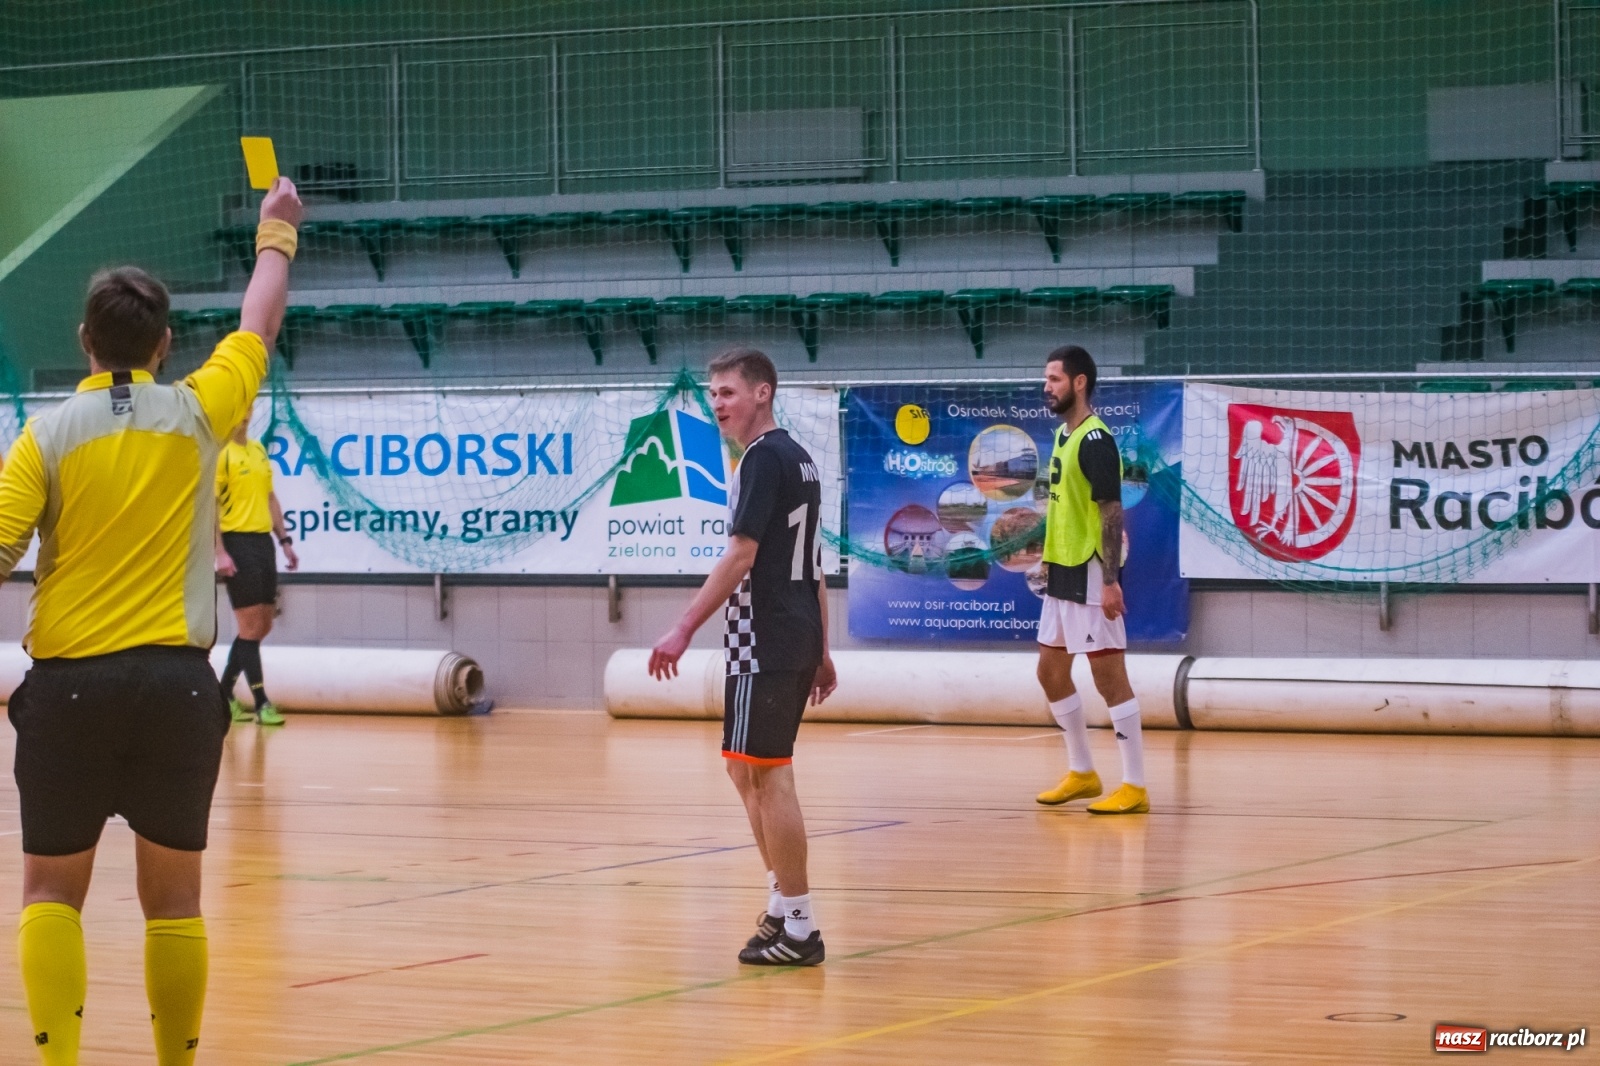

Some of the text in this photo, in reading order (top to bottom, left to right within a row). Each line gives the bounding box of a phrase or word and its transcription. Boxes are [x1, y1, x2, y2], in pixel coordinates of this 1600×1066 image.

[1091, 402, 1140, 418] kreacji
[268, 432, 574, 477] RACIBORSKI
[1392, 435, 1550, 470] MIASTO
[284, 501, 579, 543] spieramy, gramy
[608, 512, 725, 542] powiat ra
[608, 542, 726, 558] zielona oaz
[887, 599, 1016, 614] www.osir-raciborz.pl
[888, 617, 1040, 631] www.aquapark.raciborz
